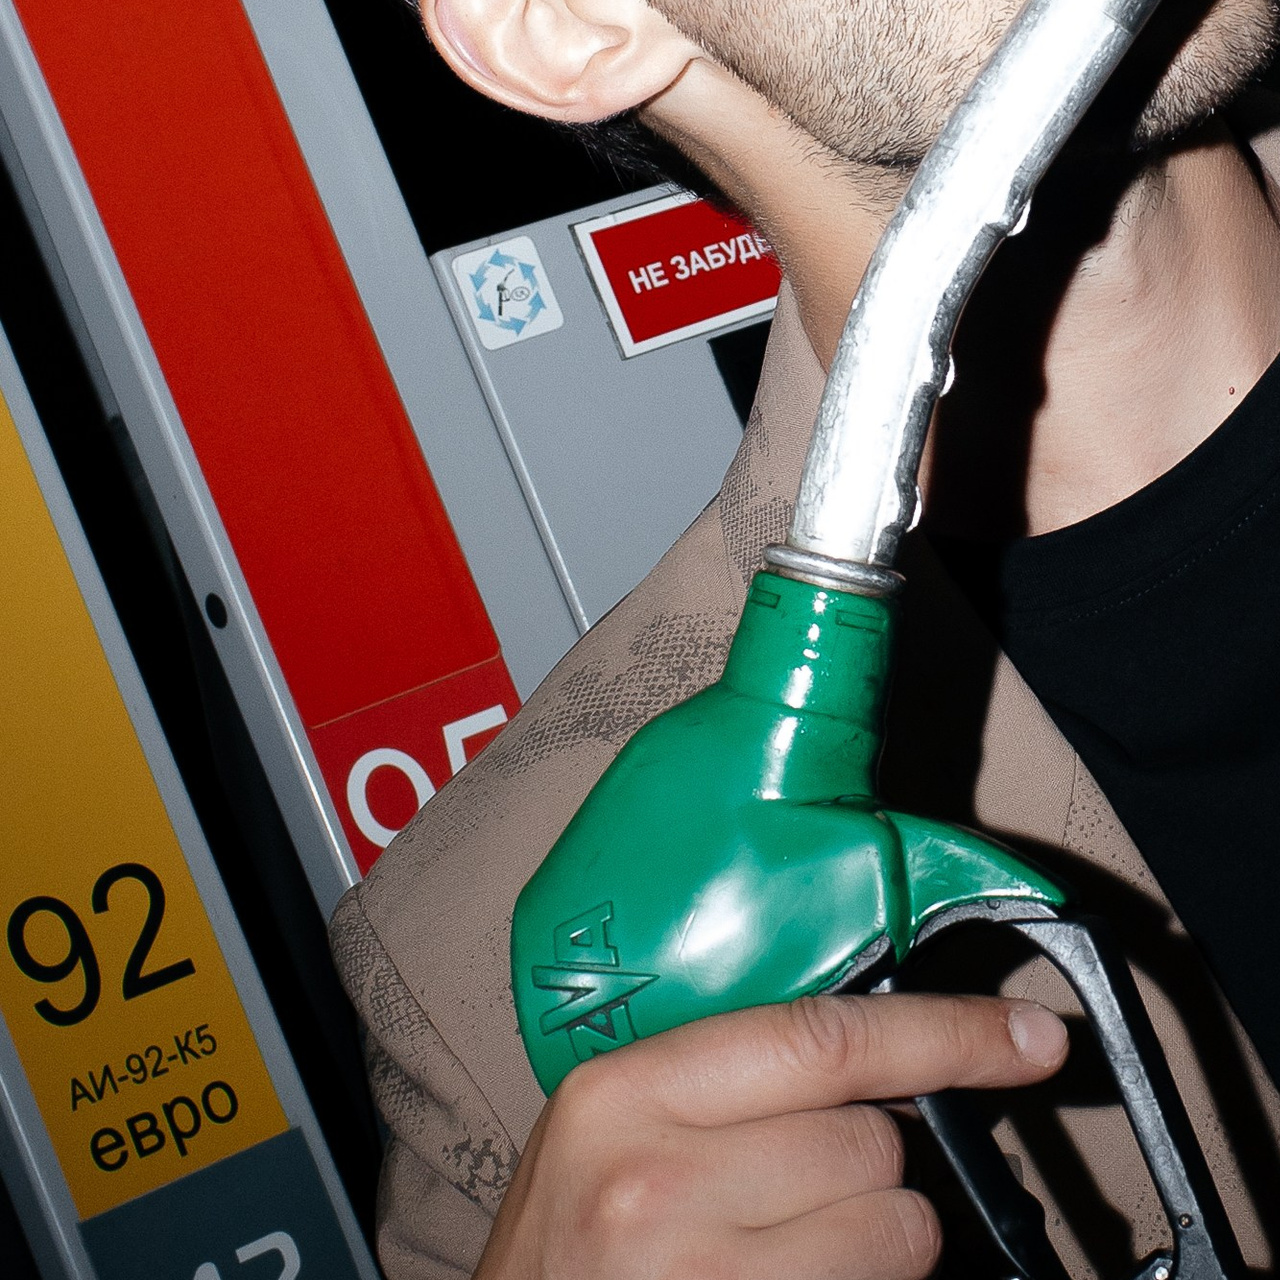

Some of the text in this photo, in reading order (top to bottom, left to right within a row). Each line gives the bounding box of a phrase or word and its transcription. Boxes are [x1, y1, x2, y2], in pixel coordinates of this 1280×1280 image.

[628, 261, 670, 295] НЕ
[7, 862, 197, 1027] 92
[70, 1023, 218, 1112] АИ-92-К5
[89, 1080, 239, 1173] евро
